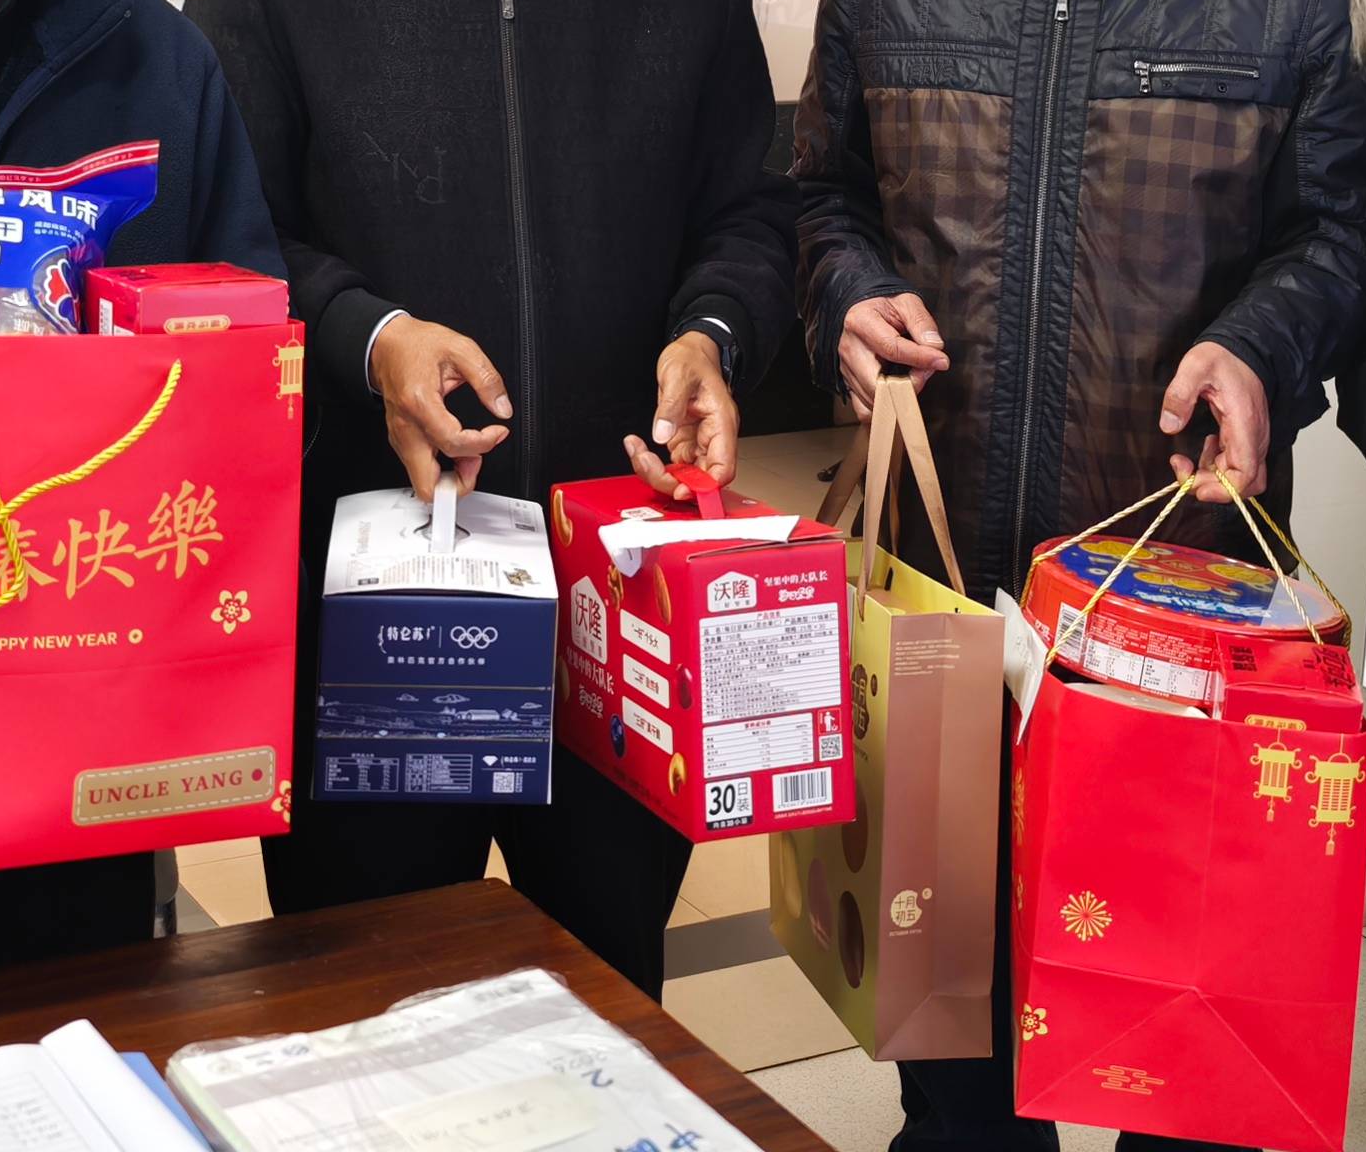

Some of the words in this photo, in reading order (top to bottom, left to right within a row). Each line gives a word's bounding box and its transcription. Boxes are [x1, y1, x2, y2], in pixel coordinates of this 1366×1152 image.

[714, 579, 751, 602] 沃隆
[573, 590, 603, 642] 沃隆
[33, 634, 72, 650] NEW
[76, 631, 118, 649] YEAR
[88, 778, 171, 806] UNCLE
[181, 769, 245, 795] YANG
[708, 783, 736, 816] 30
